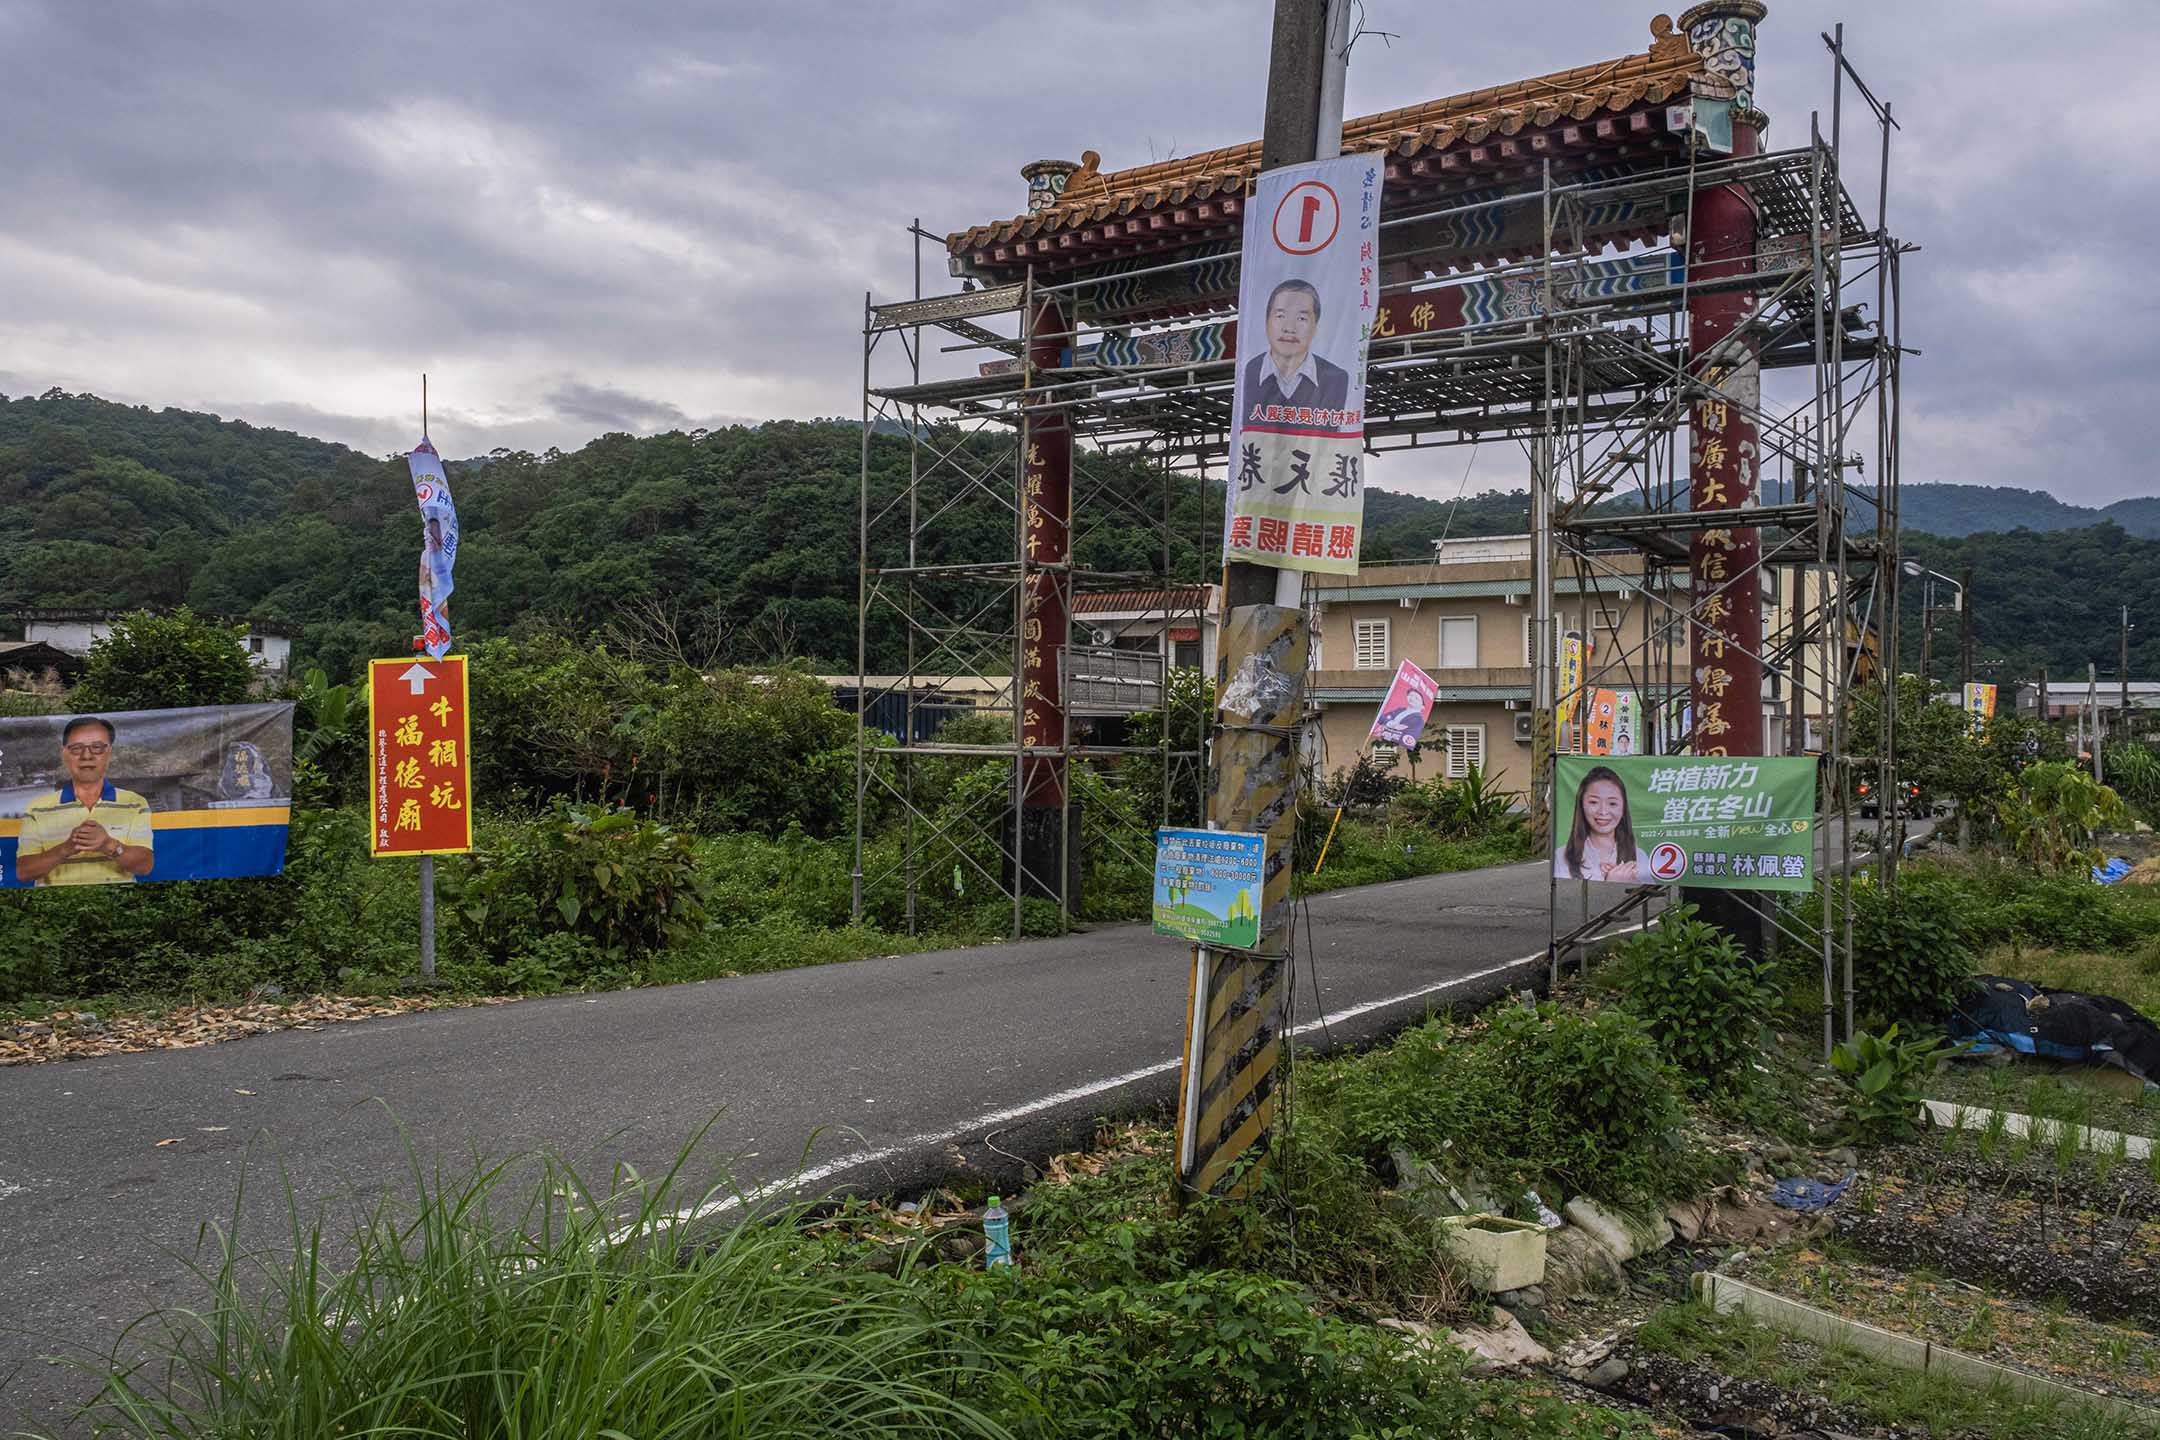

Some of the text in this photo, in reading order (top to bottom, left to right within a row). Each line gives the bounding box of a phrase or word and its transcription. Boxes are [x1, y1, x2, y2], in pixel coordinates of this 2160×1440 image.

[428, 695, 462, 810] 牛稠坑
[394, 714, 426, 832] 福德廟
[1648, 763, 1759, 793] 培植新力
[1660, 792, 1773, 823] 螢在冬山
[1704, 824, 1730, 840] 全新
[1764, 823, 1792, 838] 全心
[1657, 847, 1677, 874] 2
[1732, 854, 1806, 878] 林佩螢
